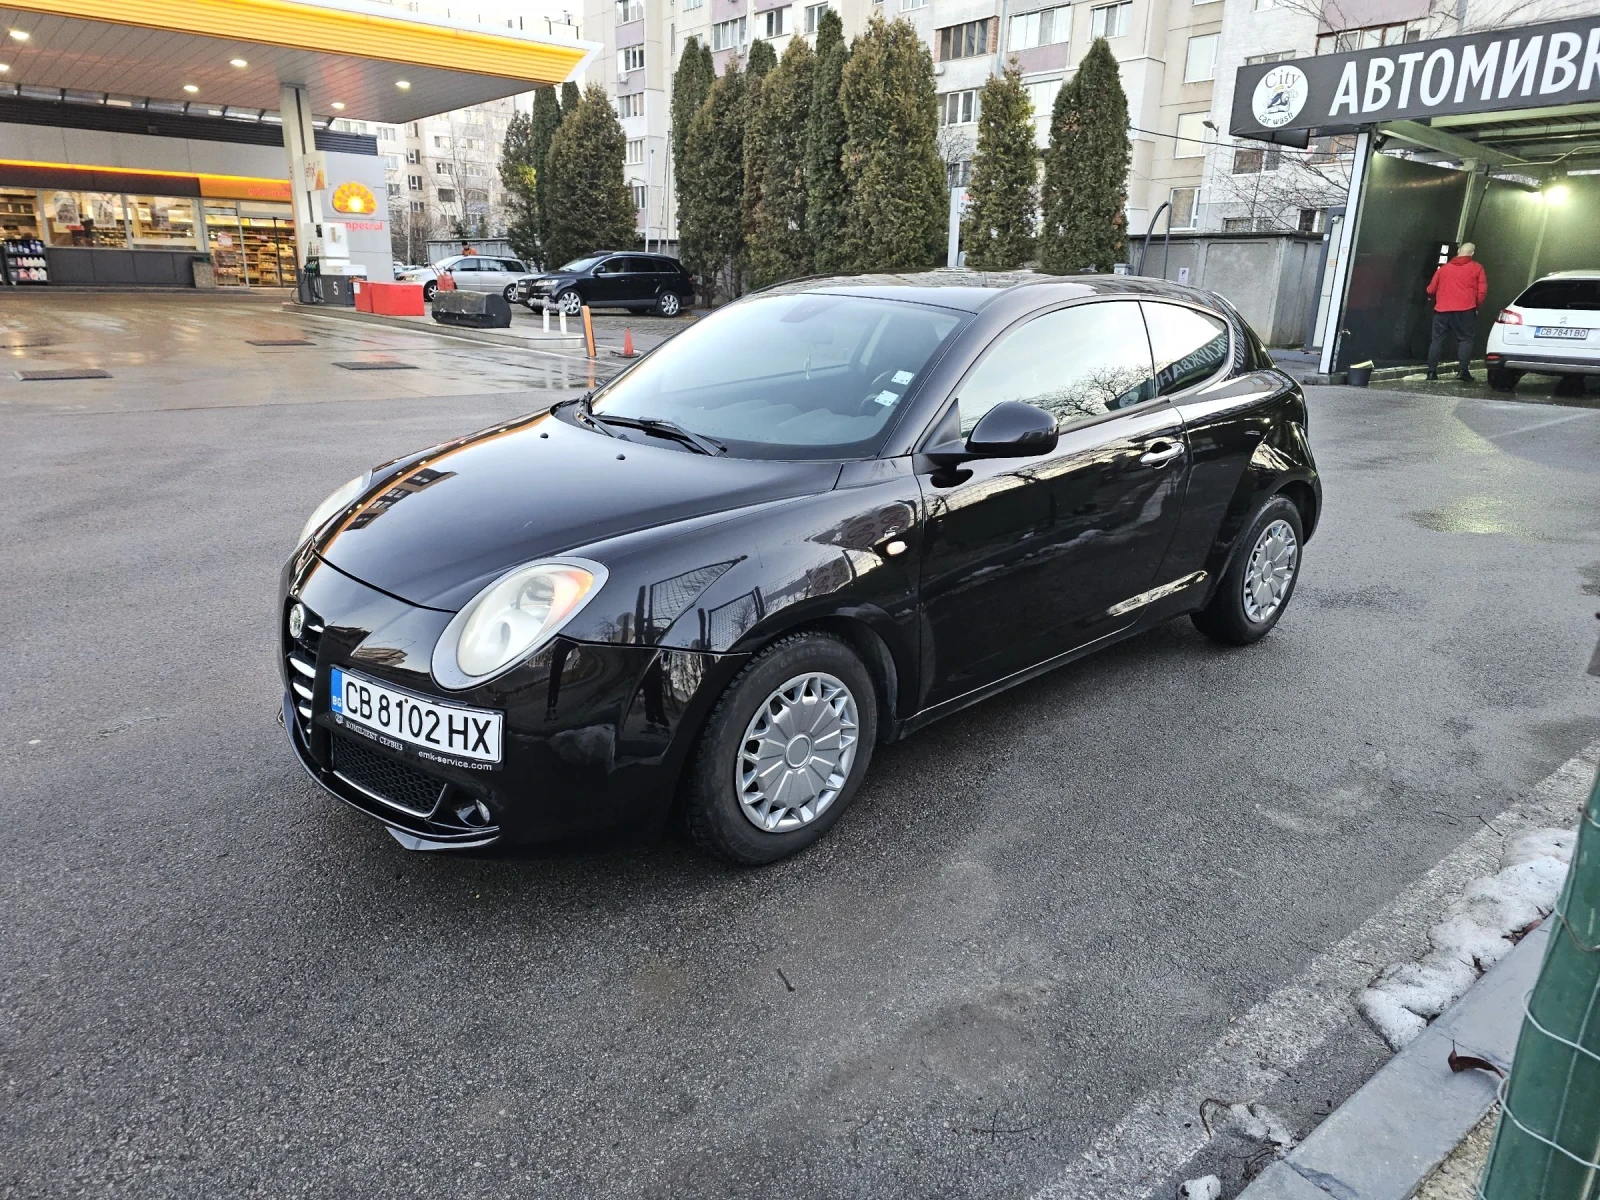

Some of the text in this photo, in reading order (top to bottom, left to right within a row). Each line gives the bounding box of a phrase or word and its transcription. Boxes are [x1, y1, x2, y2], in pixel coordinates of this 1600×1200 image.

[1265, 69, 1301, 88] City
[1258, 112, 1293, 125] car wash
[333, 281, 339, 295] 5
[332, 695, 342, 707] BG
[418, 750, 492, 771] emk-service.com
